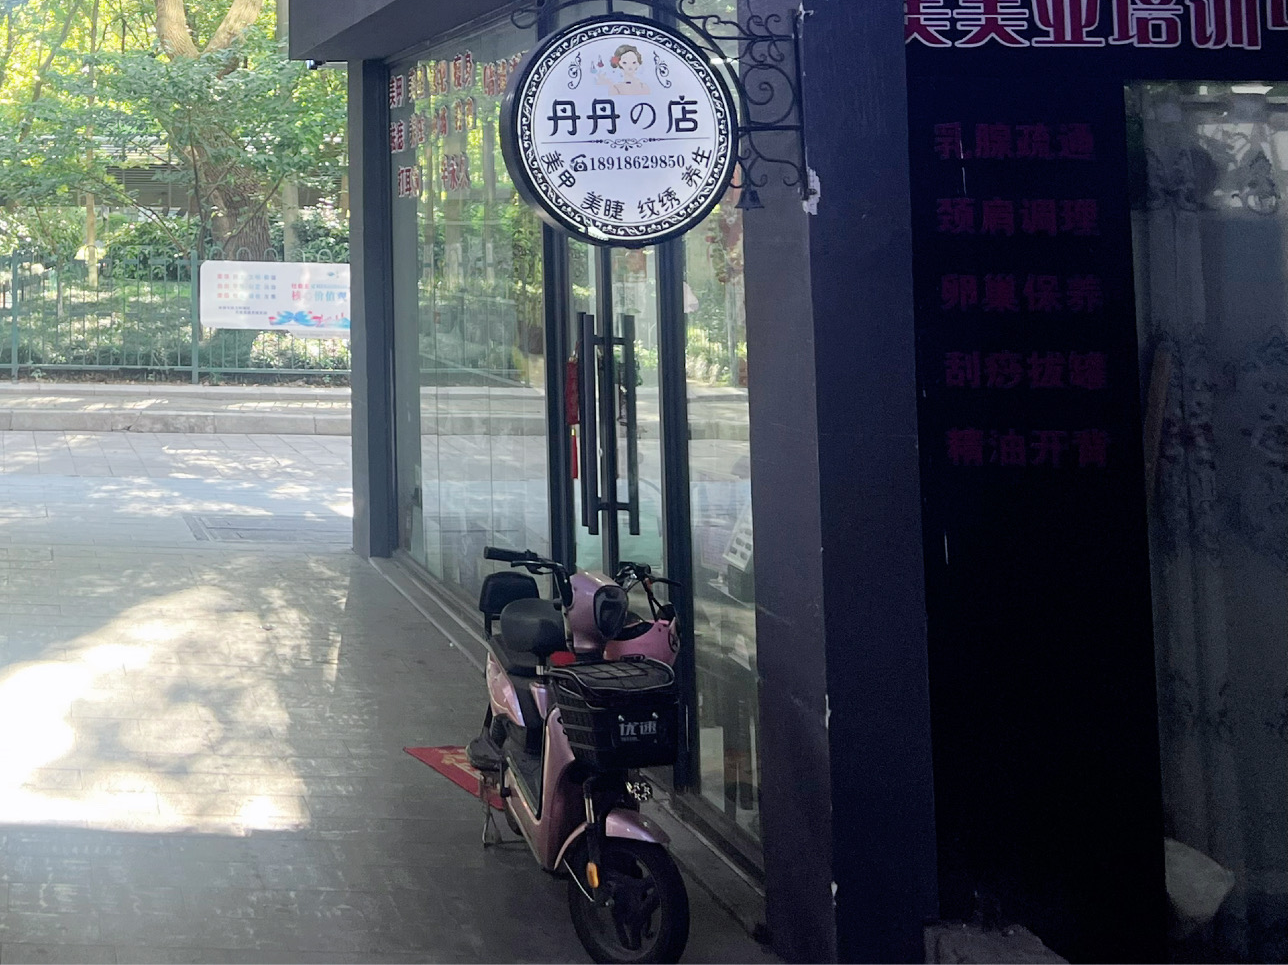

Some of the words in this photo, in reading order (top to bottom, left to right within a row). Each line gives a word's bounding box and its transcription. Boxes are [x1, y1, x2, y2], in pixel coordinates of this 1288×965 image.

[546, 95, 699, 137] 丹丹の店
[589, 154, 686, 172] 18918629850
[540, 150, 576, 189] 美甲
[580, 190, 625, 222] 美睫
[637, 187, 681, 220] 纹绣
[680, 146, 713, 188] 养生
[936, 197, 1100, 236] 颈肩调理
[941, 273, 1105, 313] 卵巢保养
[945, 350, 1108, 389] 刮痧拔罐
